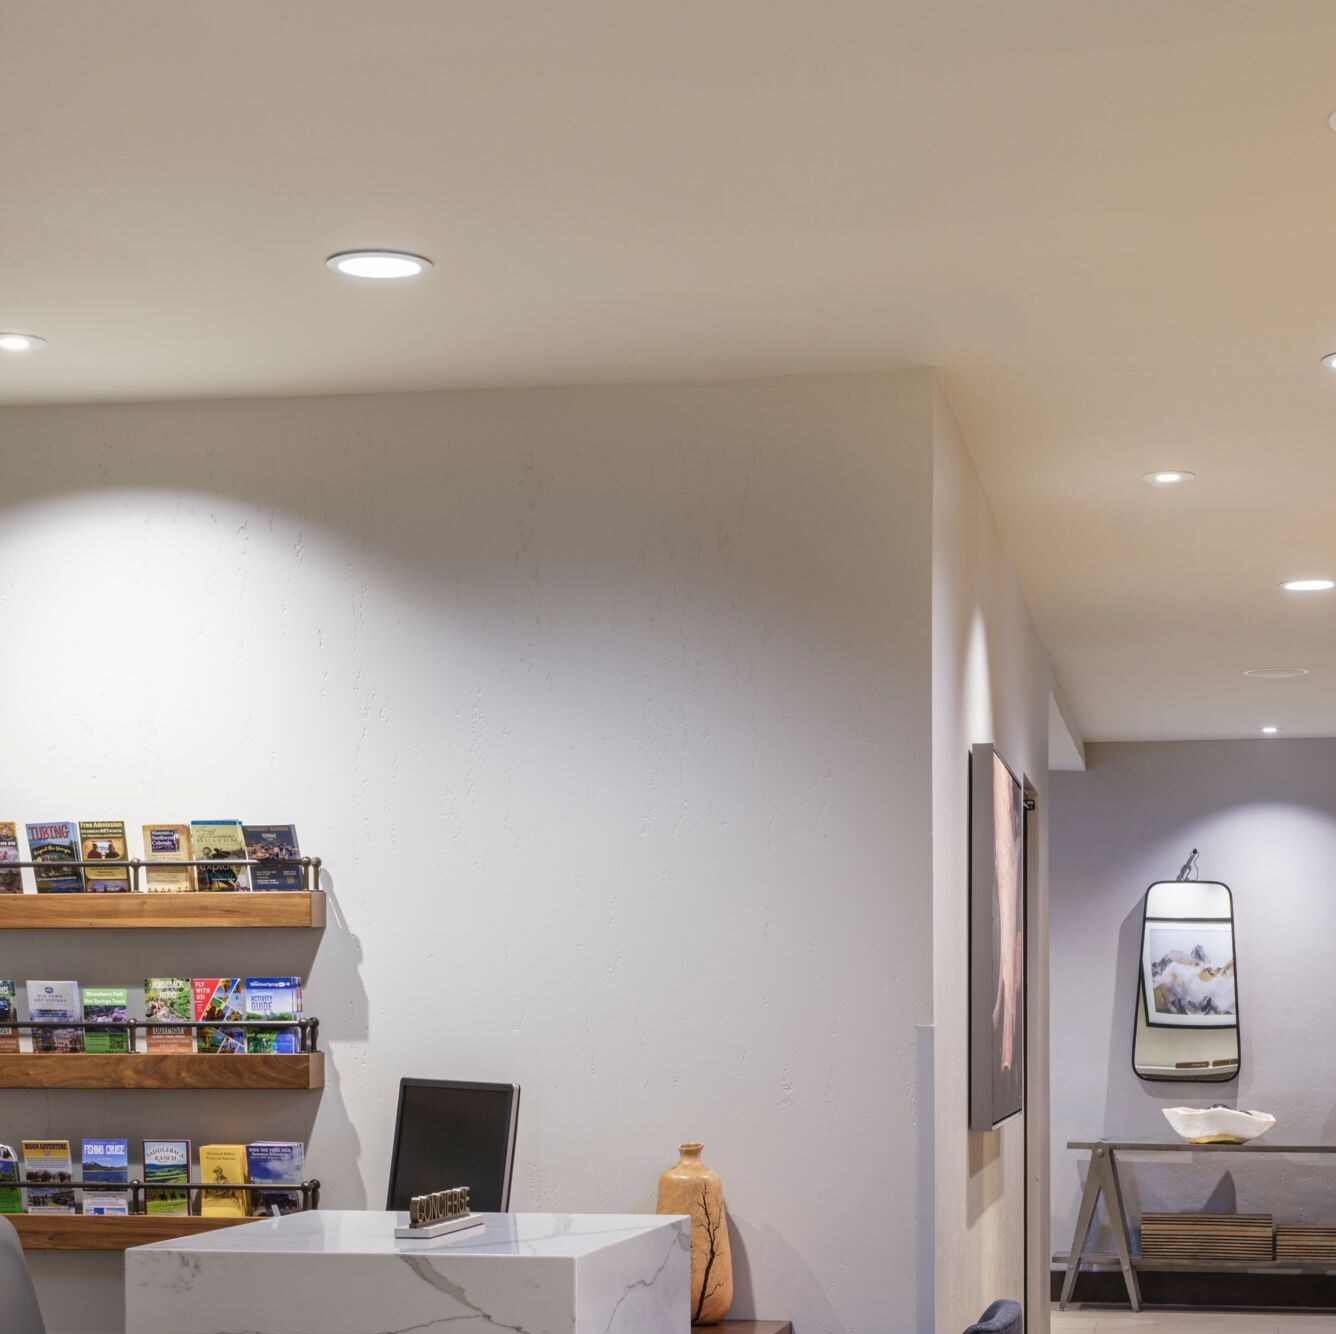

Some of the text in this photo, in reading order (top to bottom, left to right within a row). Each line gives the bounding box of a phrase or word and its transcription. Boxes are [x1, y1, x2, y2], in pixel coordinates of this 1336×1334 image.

[28, 824, 70, 840] TUBING
[251, 1002, 273, 1011] GUIDE
[84, 1144, 125, 1155] FISHING CRUISE
[145, 1146, 184, 1158] SADDLEBACK
[154, 1154, 177, 1162] RANCH
[412, 1187, 470, 1223] CONCIERGE
